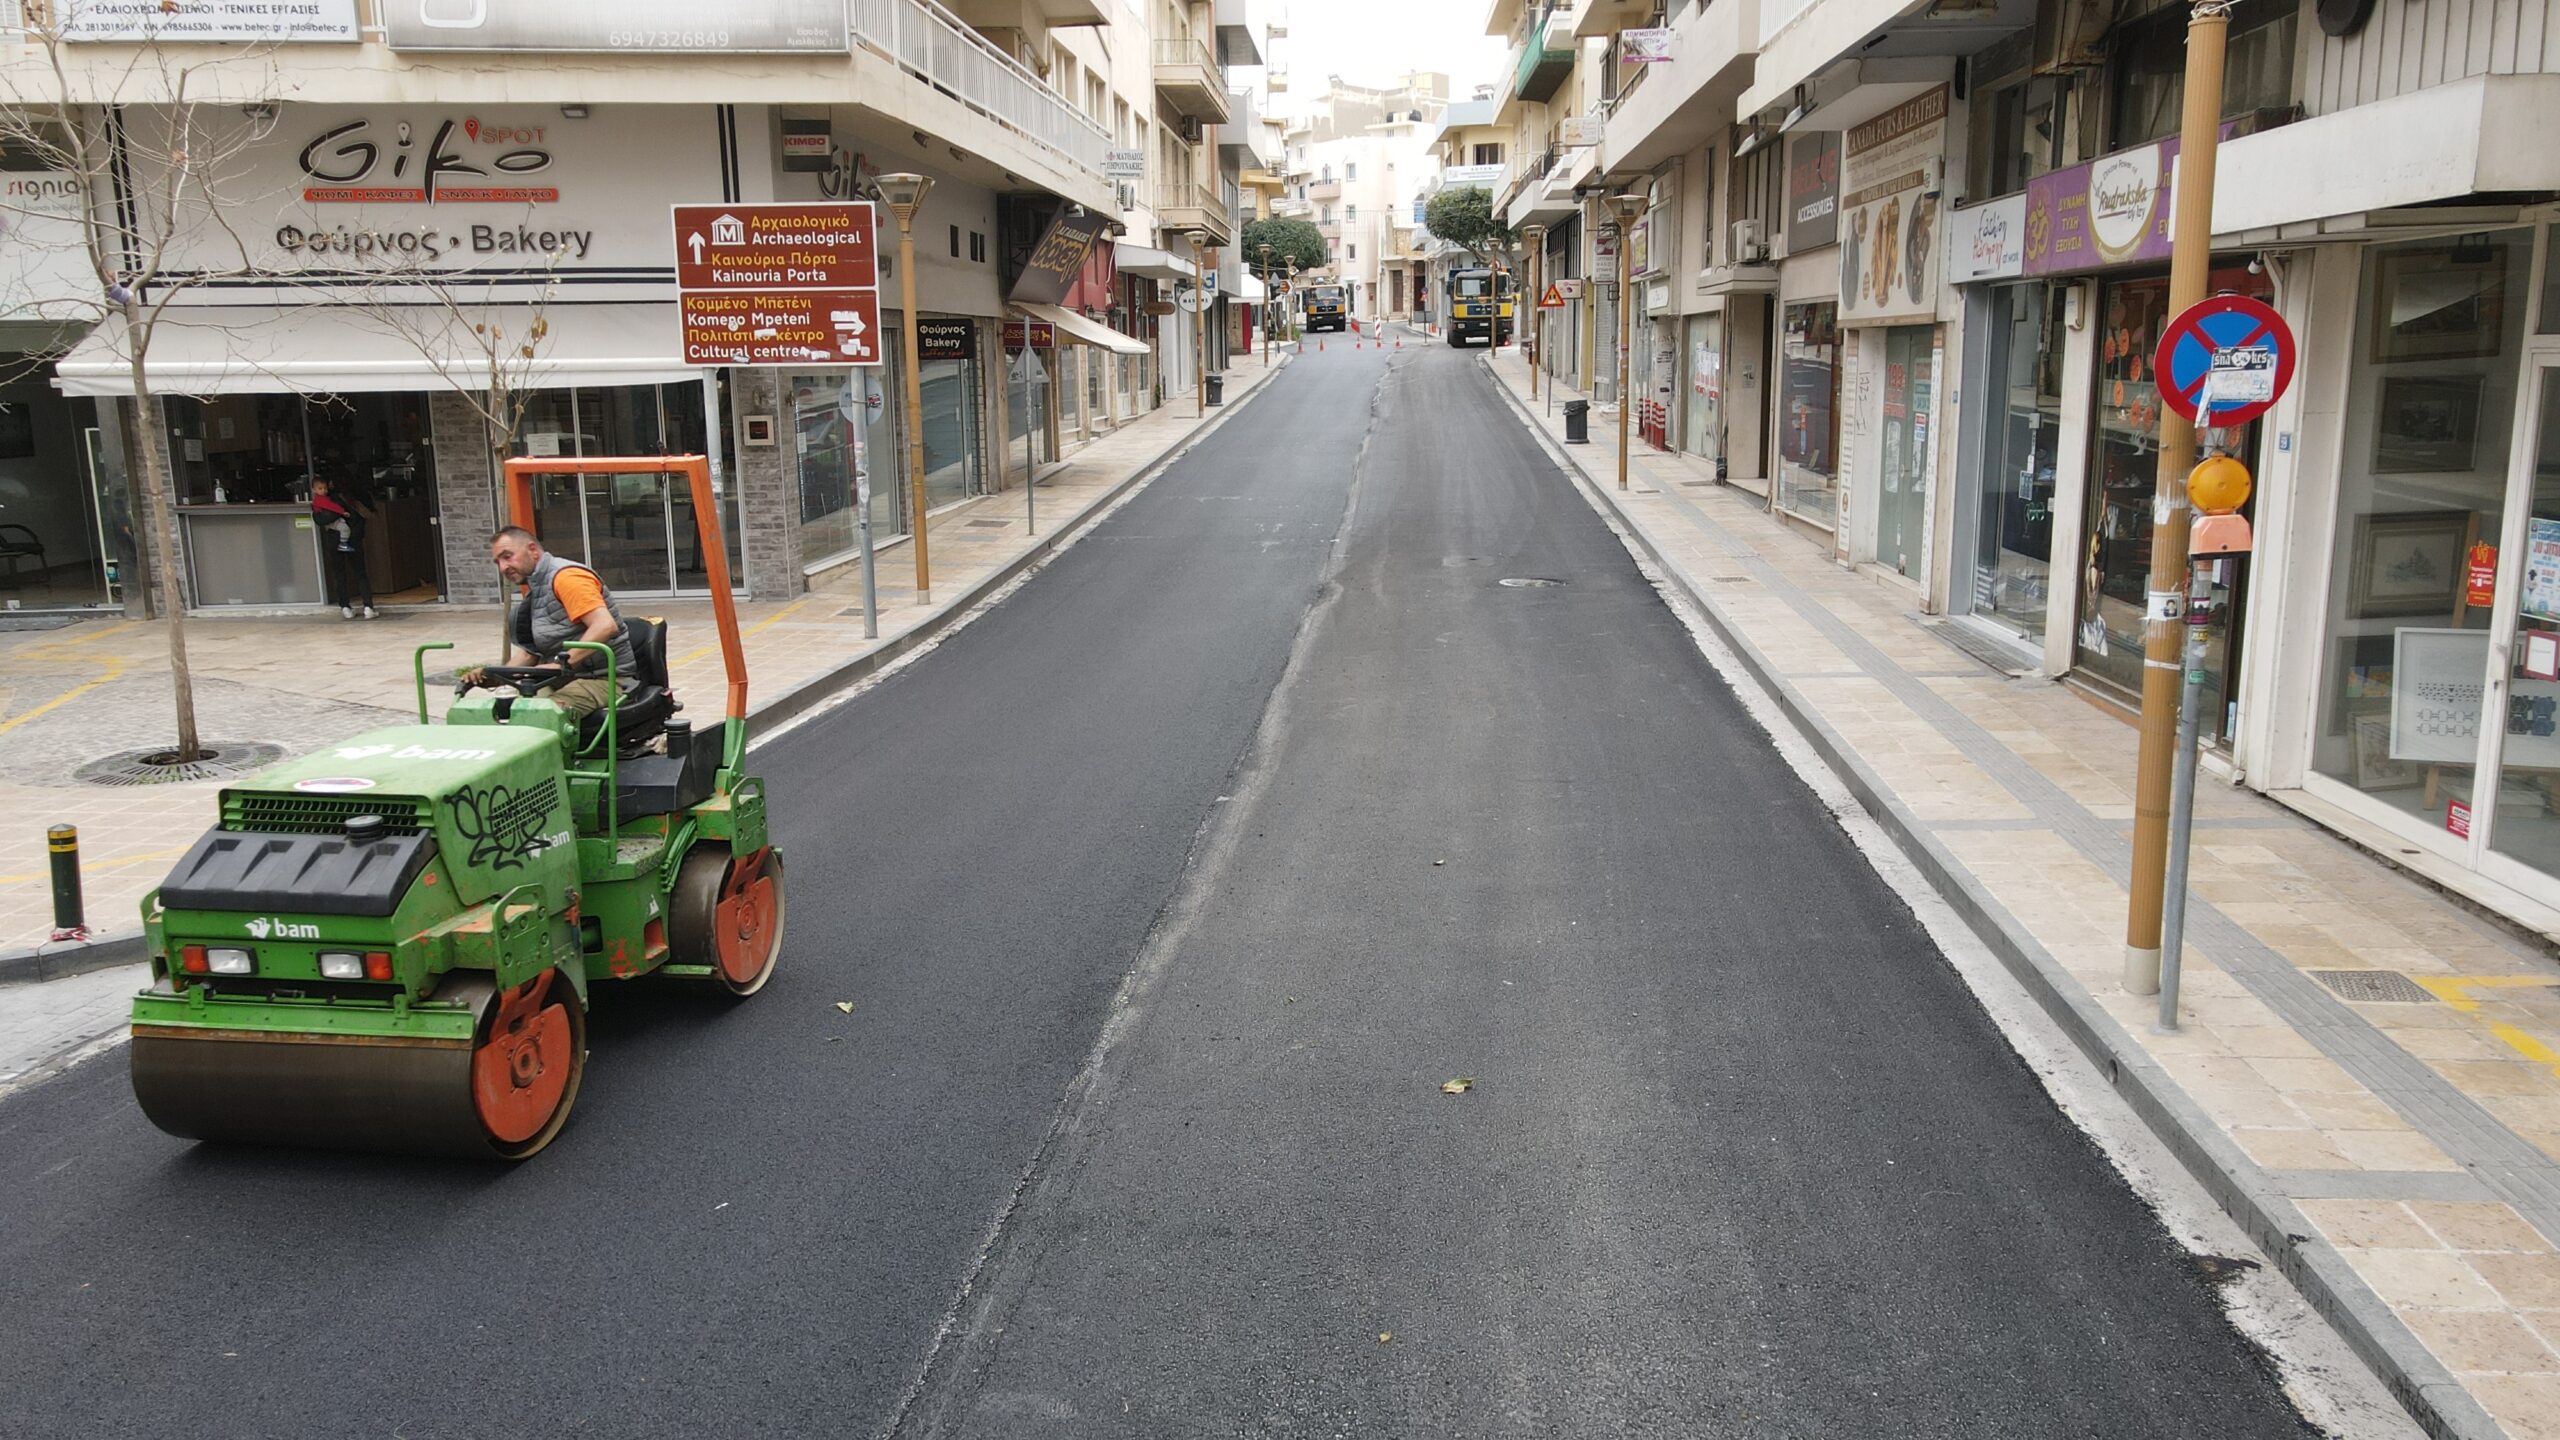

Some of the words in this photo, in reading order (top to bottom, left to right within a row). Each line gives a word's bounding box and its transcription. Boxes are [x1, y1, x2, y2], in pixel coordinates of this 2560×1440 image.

[225, 4, 267, 14] ΓΕΝΙΚΕΣ
[272, 4, 319, 14] ΕΡΓΑΣΙΕΣ
[221, 23, 281, 34] www.betec.gr
[290, 23, 348, 34] info@betec.gr
[609, 31, 729, 47] 6947326849
[1904, 90, 1945, 130] LEATHER
[482, 128, 545, 143] SPOT
[784, 137, 826, 146] KIMBO
[300, 120, 553, 207] Giko
[8, 180, 80, 201] signia
[2058, 193, 2086, 212] ΔΥΝΑΜΗ
[751, 214, 850, 231] Αρχαιολογικό
[2062, 216, 2079, 231] ΤΥΧΗ
[277, 224, 440, 262] Φούρνος
[471, 224, 592, 260] Bakery
[752, 231, 862, 246] Archaeological
[711, 252, 785, 268] Καινούρια
[790, 252, 837, 268] Πόρτα
[713, 269, 781, 282] Kainouria
[787, 269, 827, 282] Porta
[687, 297, 748, 312] Κομμένο
[754, 296, 812, 310] Μπετένι
[752, 312, 810, 328] Mpeteni
[776, 328, 825, 344] κέντρο
[920, 325, 966, 336] Φούρνος
[689, 344, 748, 358] Cultural
[753, 346, 800, 358] centre
[925, 338, 961, 349] Bakery
[390, 745, 496, 759] bam
[274, 917, 320, 939] bam
